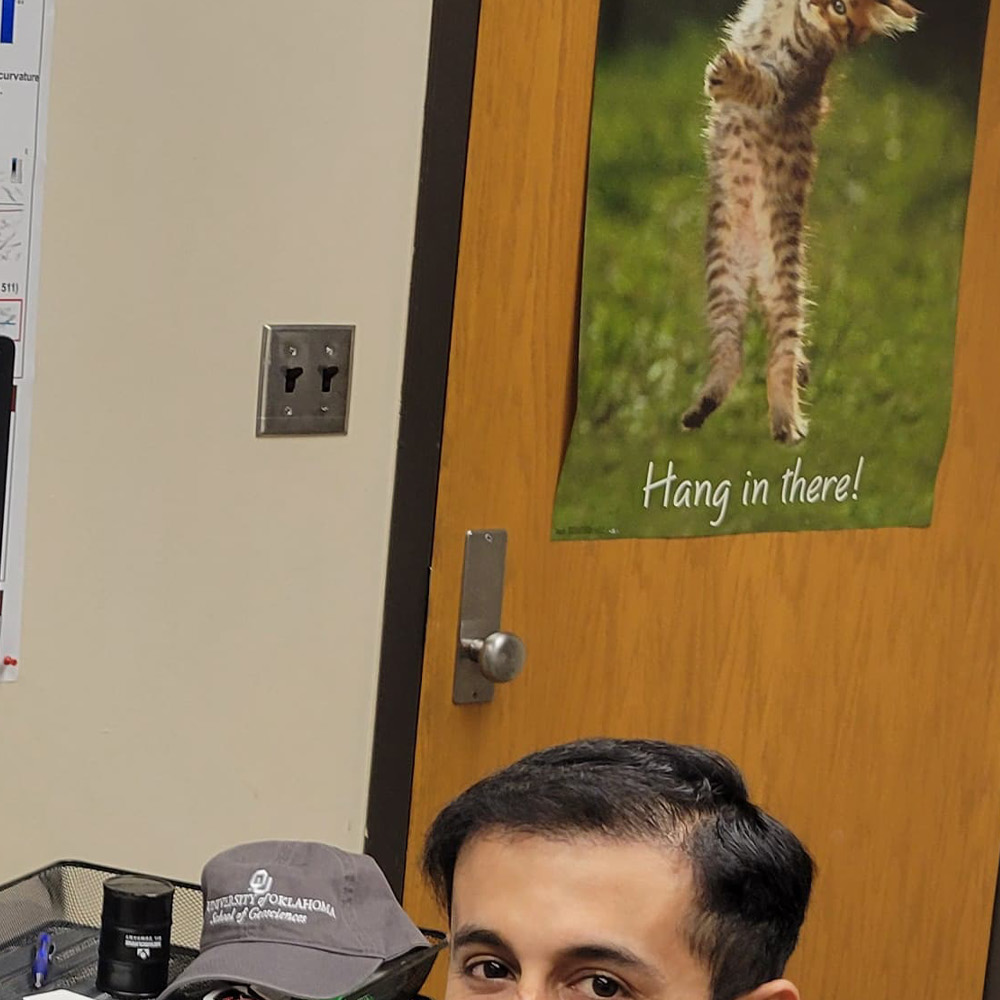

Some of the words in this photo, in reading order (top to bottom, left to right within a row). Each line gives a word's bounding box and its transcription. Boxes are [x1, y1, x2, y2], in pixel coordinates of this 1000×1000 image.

[643, 460, 732, 527] Hang
[742, 470, 769, 506] in
[781, 456, 864, 505] there!
[268, 894, 336, 919] OKLAHOMA
